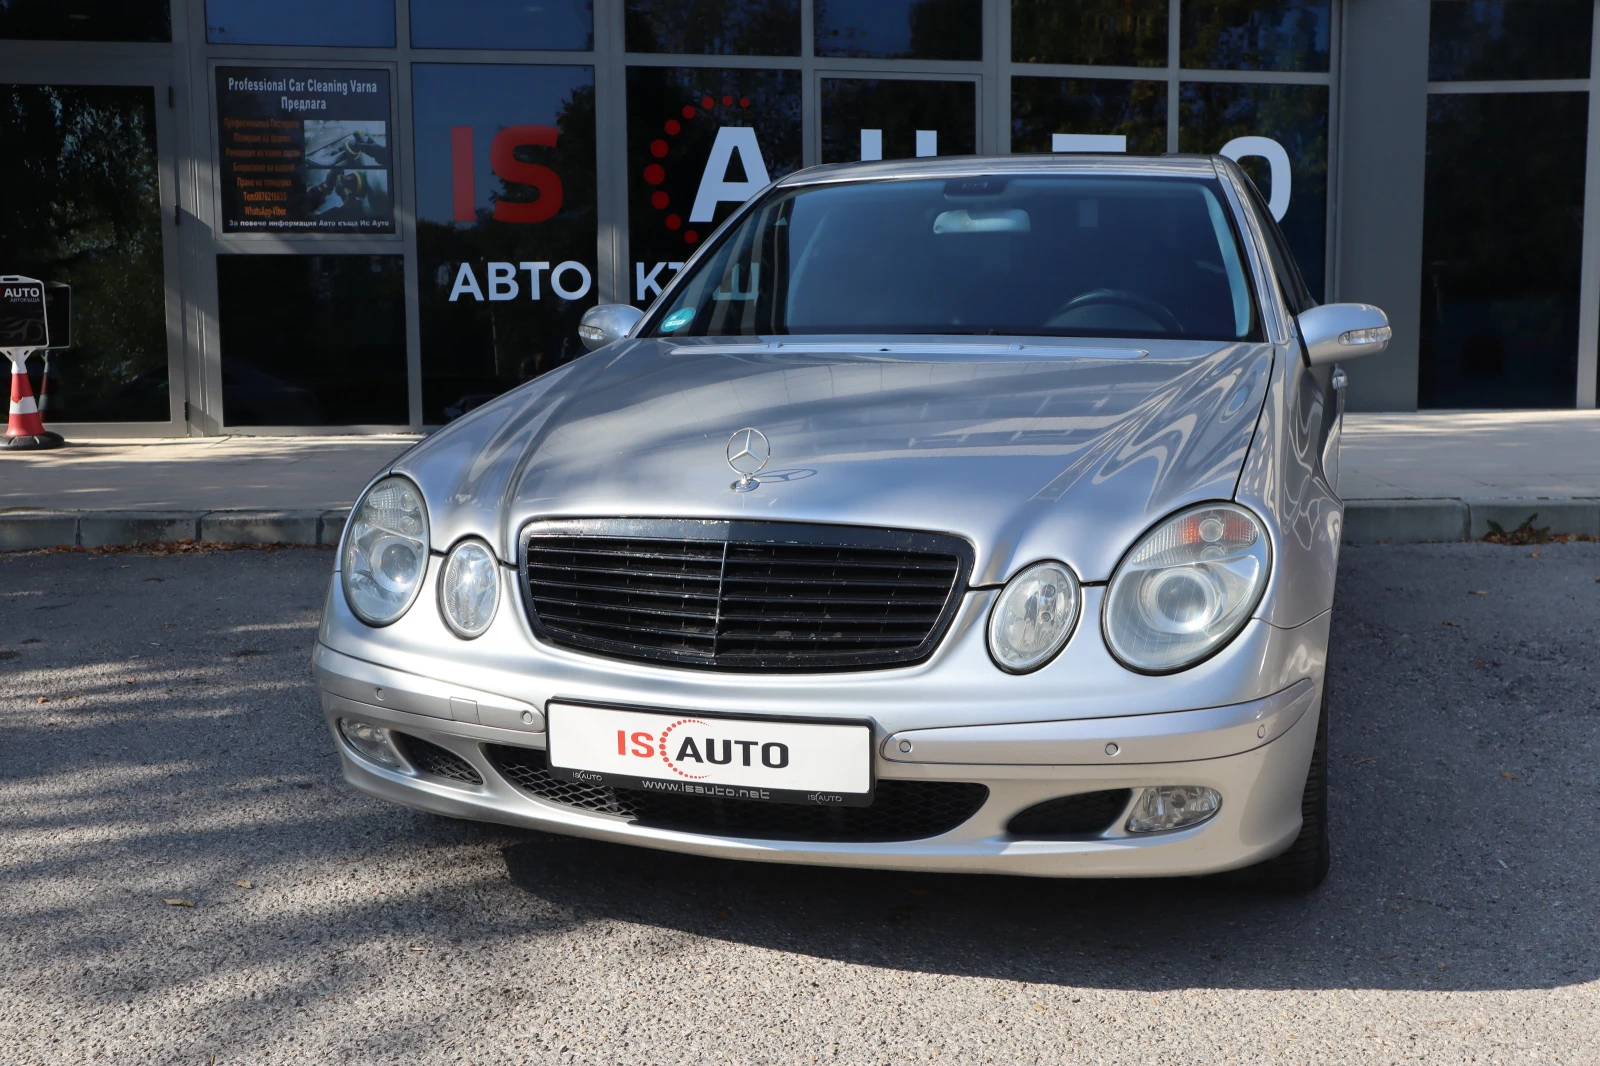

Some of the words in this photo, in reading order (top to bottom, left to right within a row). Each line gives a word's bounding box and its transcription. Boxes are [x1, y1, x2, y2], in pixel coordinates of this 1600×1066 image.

[228, 77, 286, 92] Professional
[289, 78, 305, 92] Car
[307, 78, 348, 96] Cleaning
[350, 79, 377, 93] Varna
[281, 96, 327, 112] Предлага
[451, 124, 563, 223] IS
[268, 219, 317, 228] информация
[372, 220, 389, 228] Ауто
[449, 260, 592, 302] АВТО
[4, 288, 40, 298] AUTO
[617, 730, 655, 758] IS
[675, 736, 789, 769] AUTO
[581, 773, 603, 781] AUTO
[641, 780, 770, 800] www.isauto.net
